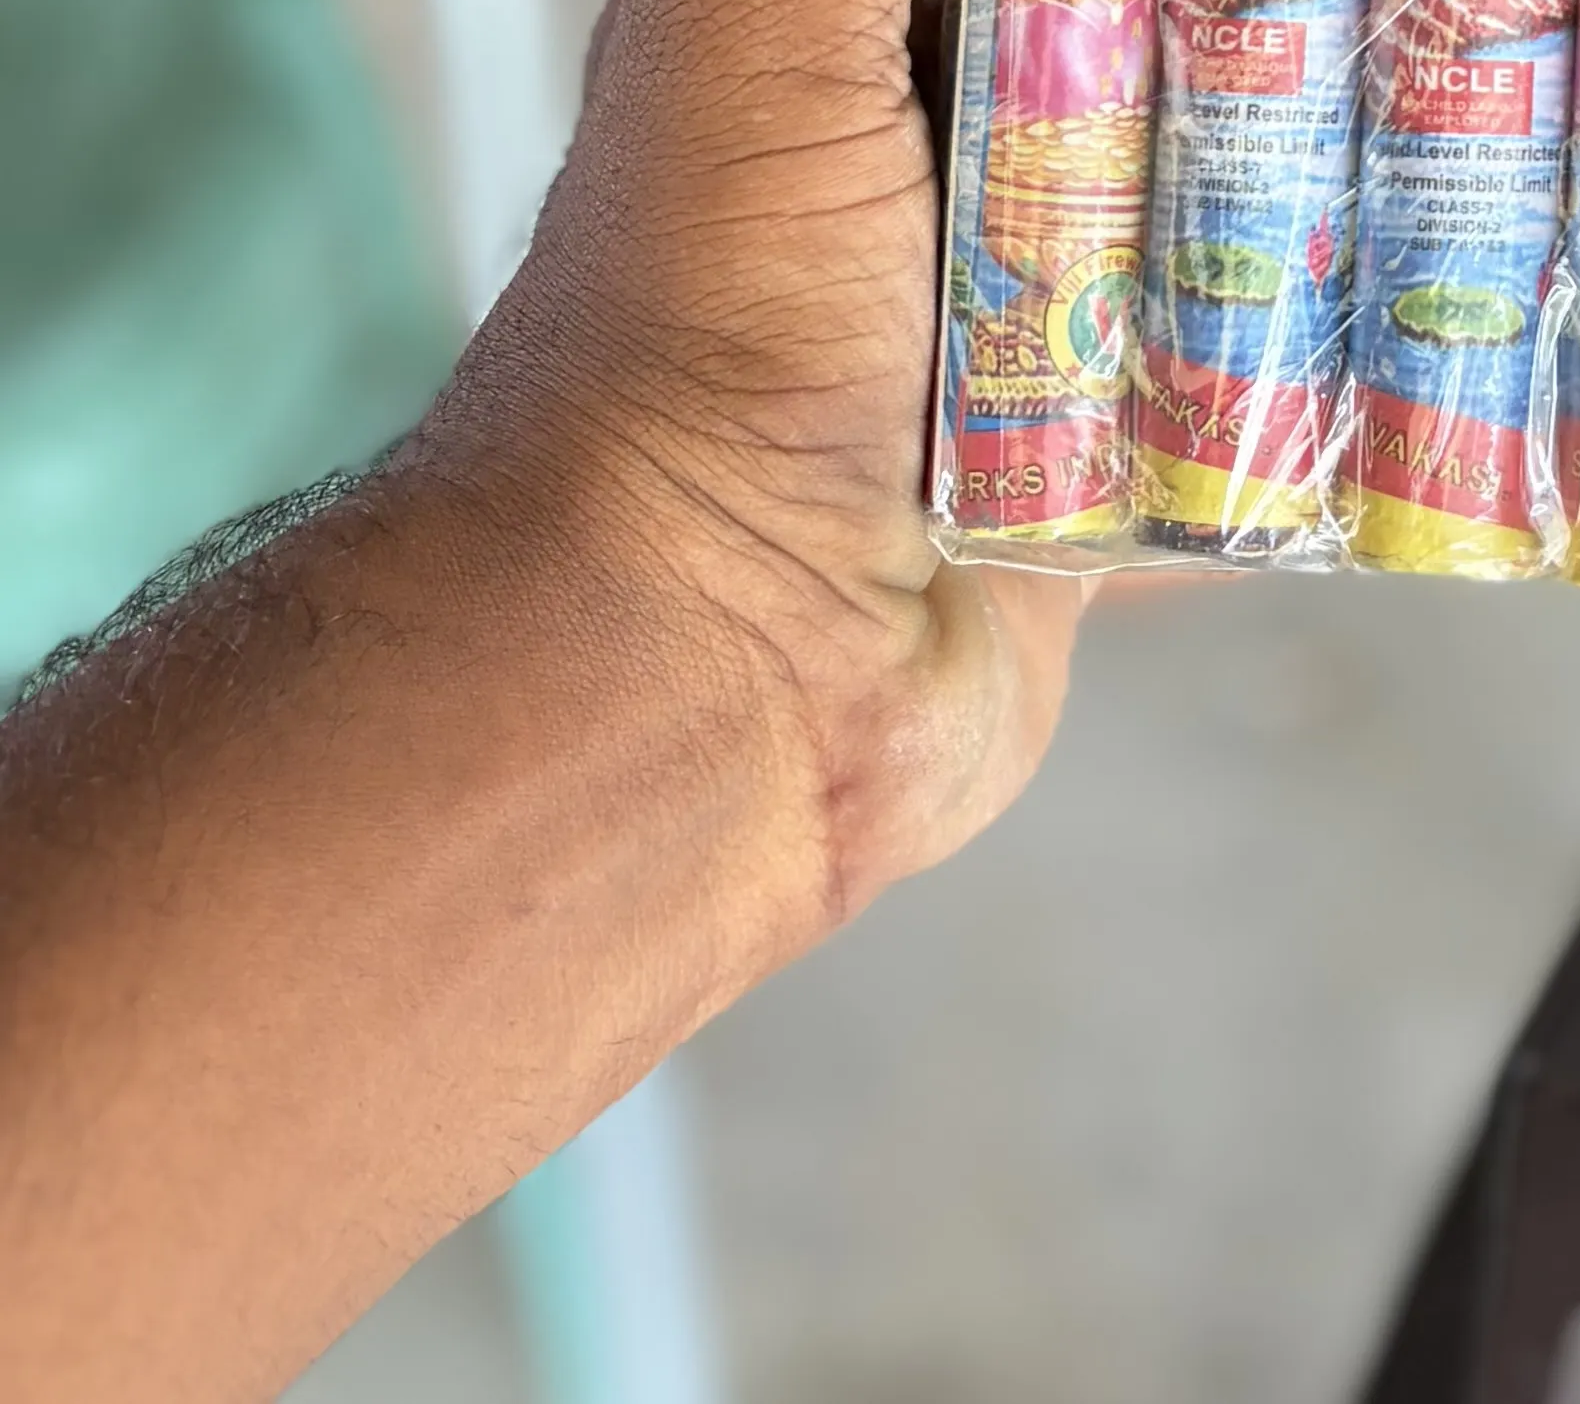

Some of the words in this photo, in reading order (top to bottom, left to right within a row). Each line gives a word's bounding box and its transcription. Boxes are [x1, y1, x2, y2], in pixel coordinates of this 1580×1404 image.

[1191, 23, 1287, 55] NCLE
[1413, 66, 1517, 95] NCLE
[1246, 102, 1339, 125] Restriced
[1417, 141, 1470, 161] Level
[1391, 170, 1505, 193] Permissible
[1511, 173, 1552, 194] Limit
[963, 464, 1047, 501] RKS
